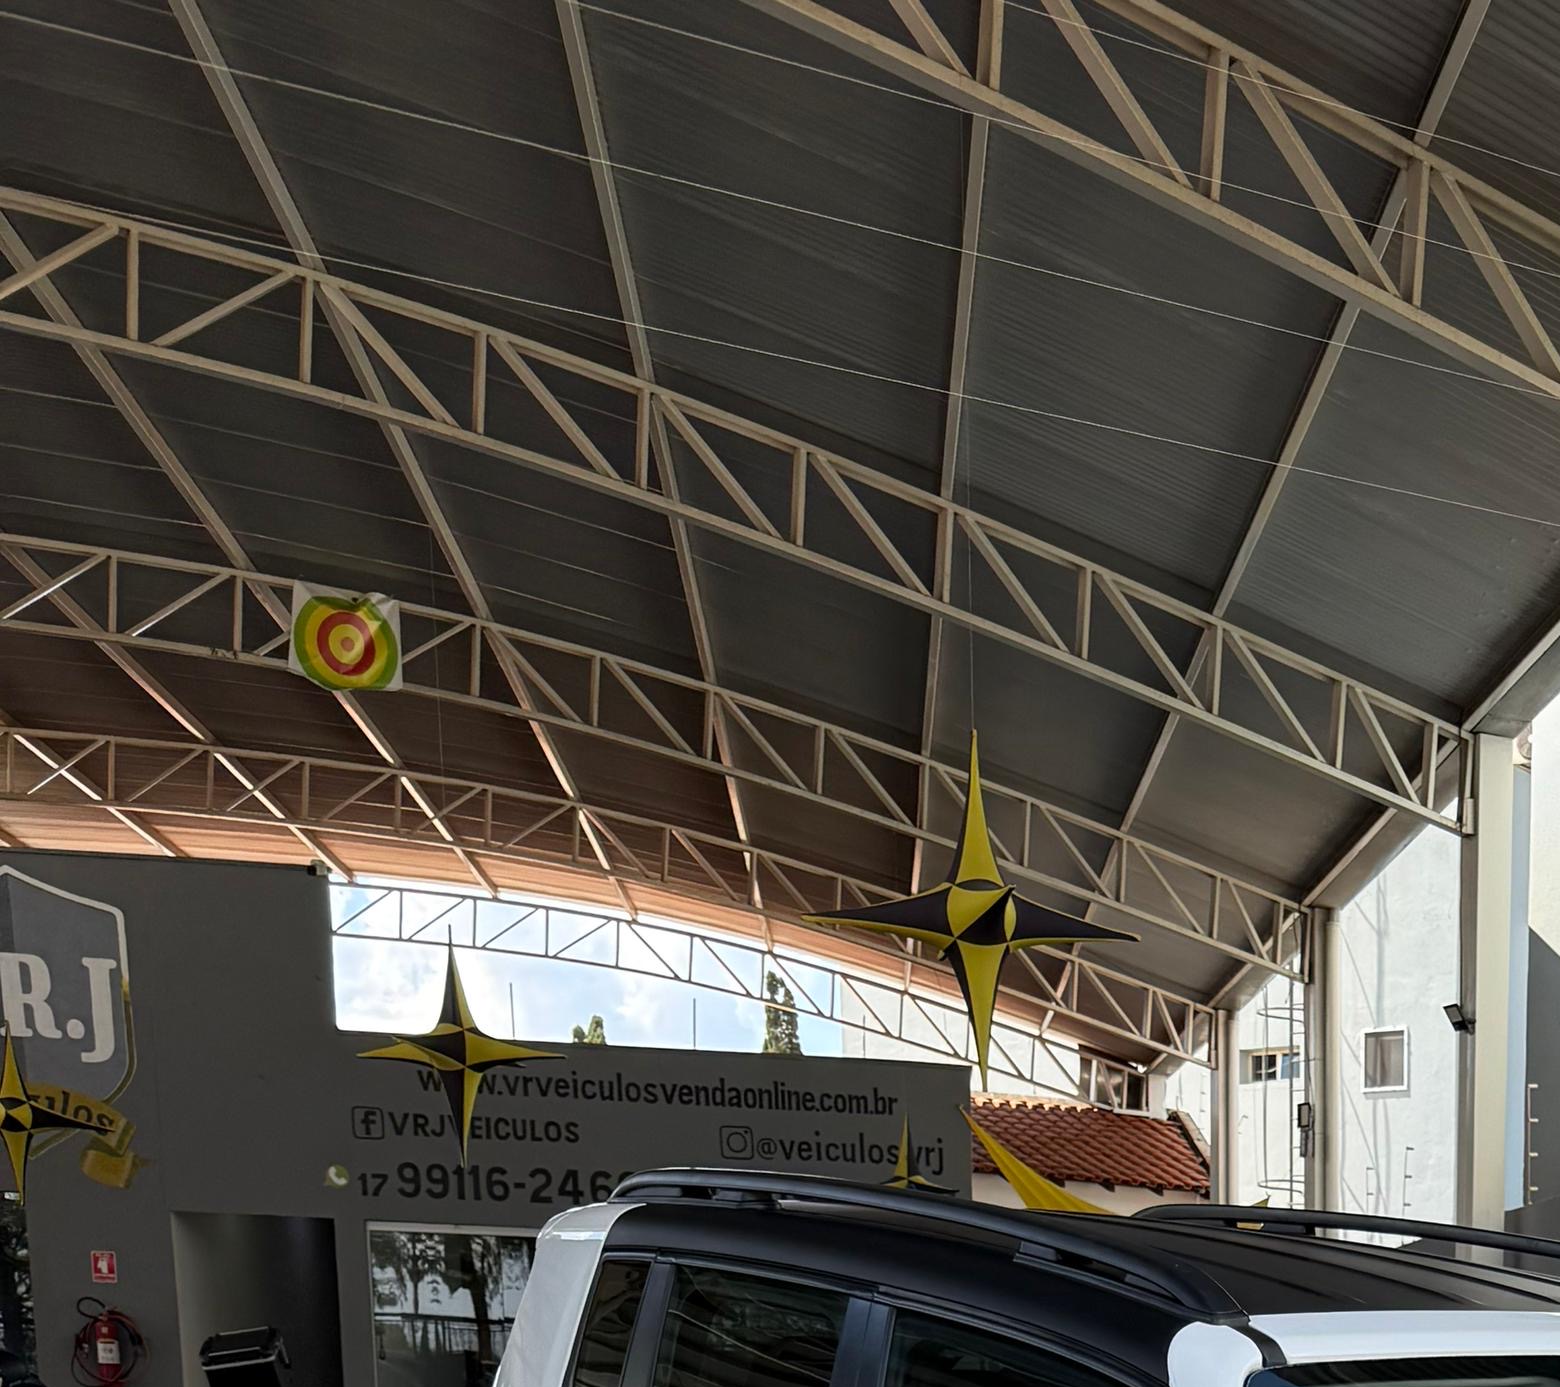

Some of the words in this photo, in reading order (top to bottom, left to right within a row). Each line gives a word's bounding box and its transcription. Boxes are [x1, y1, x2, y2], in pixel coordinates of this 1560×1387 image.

[416, 1069, 898, 1116] ww.vrveiculosvendaonline.com.br
[357, 1173, 389, 1197] 17
[396, 1161, 634, 1204] 99116-246
